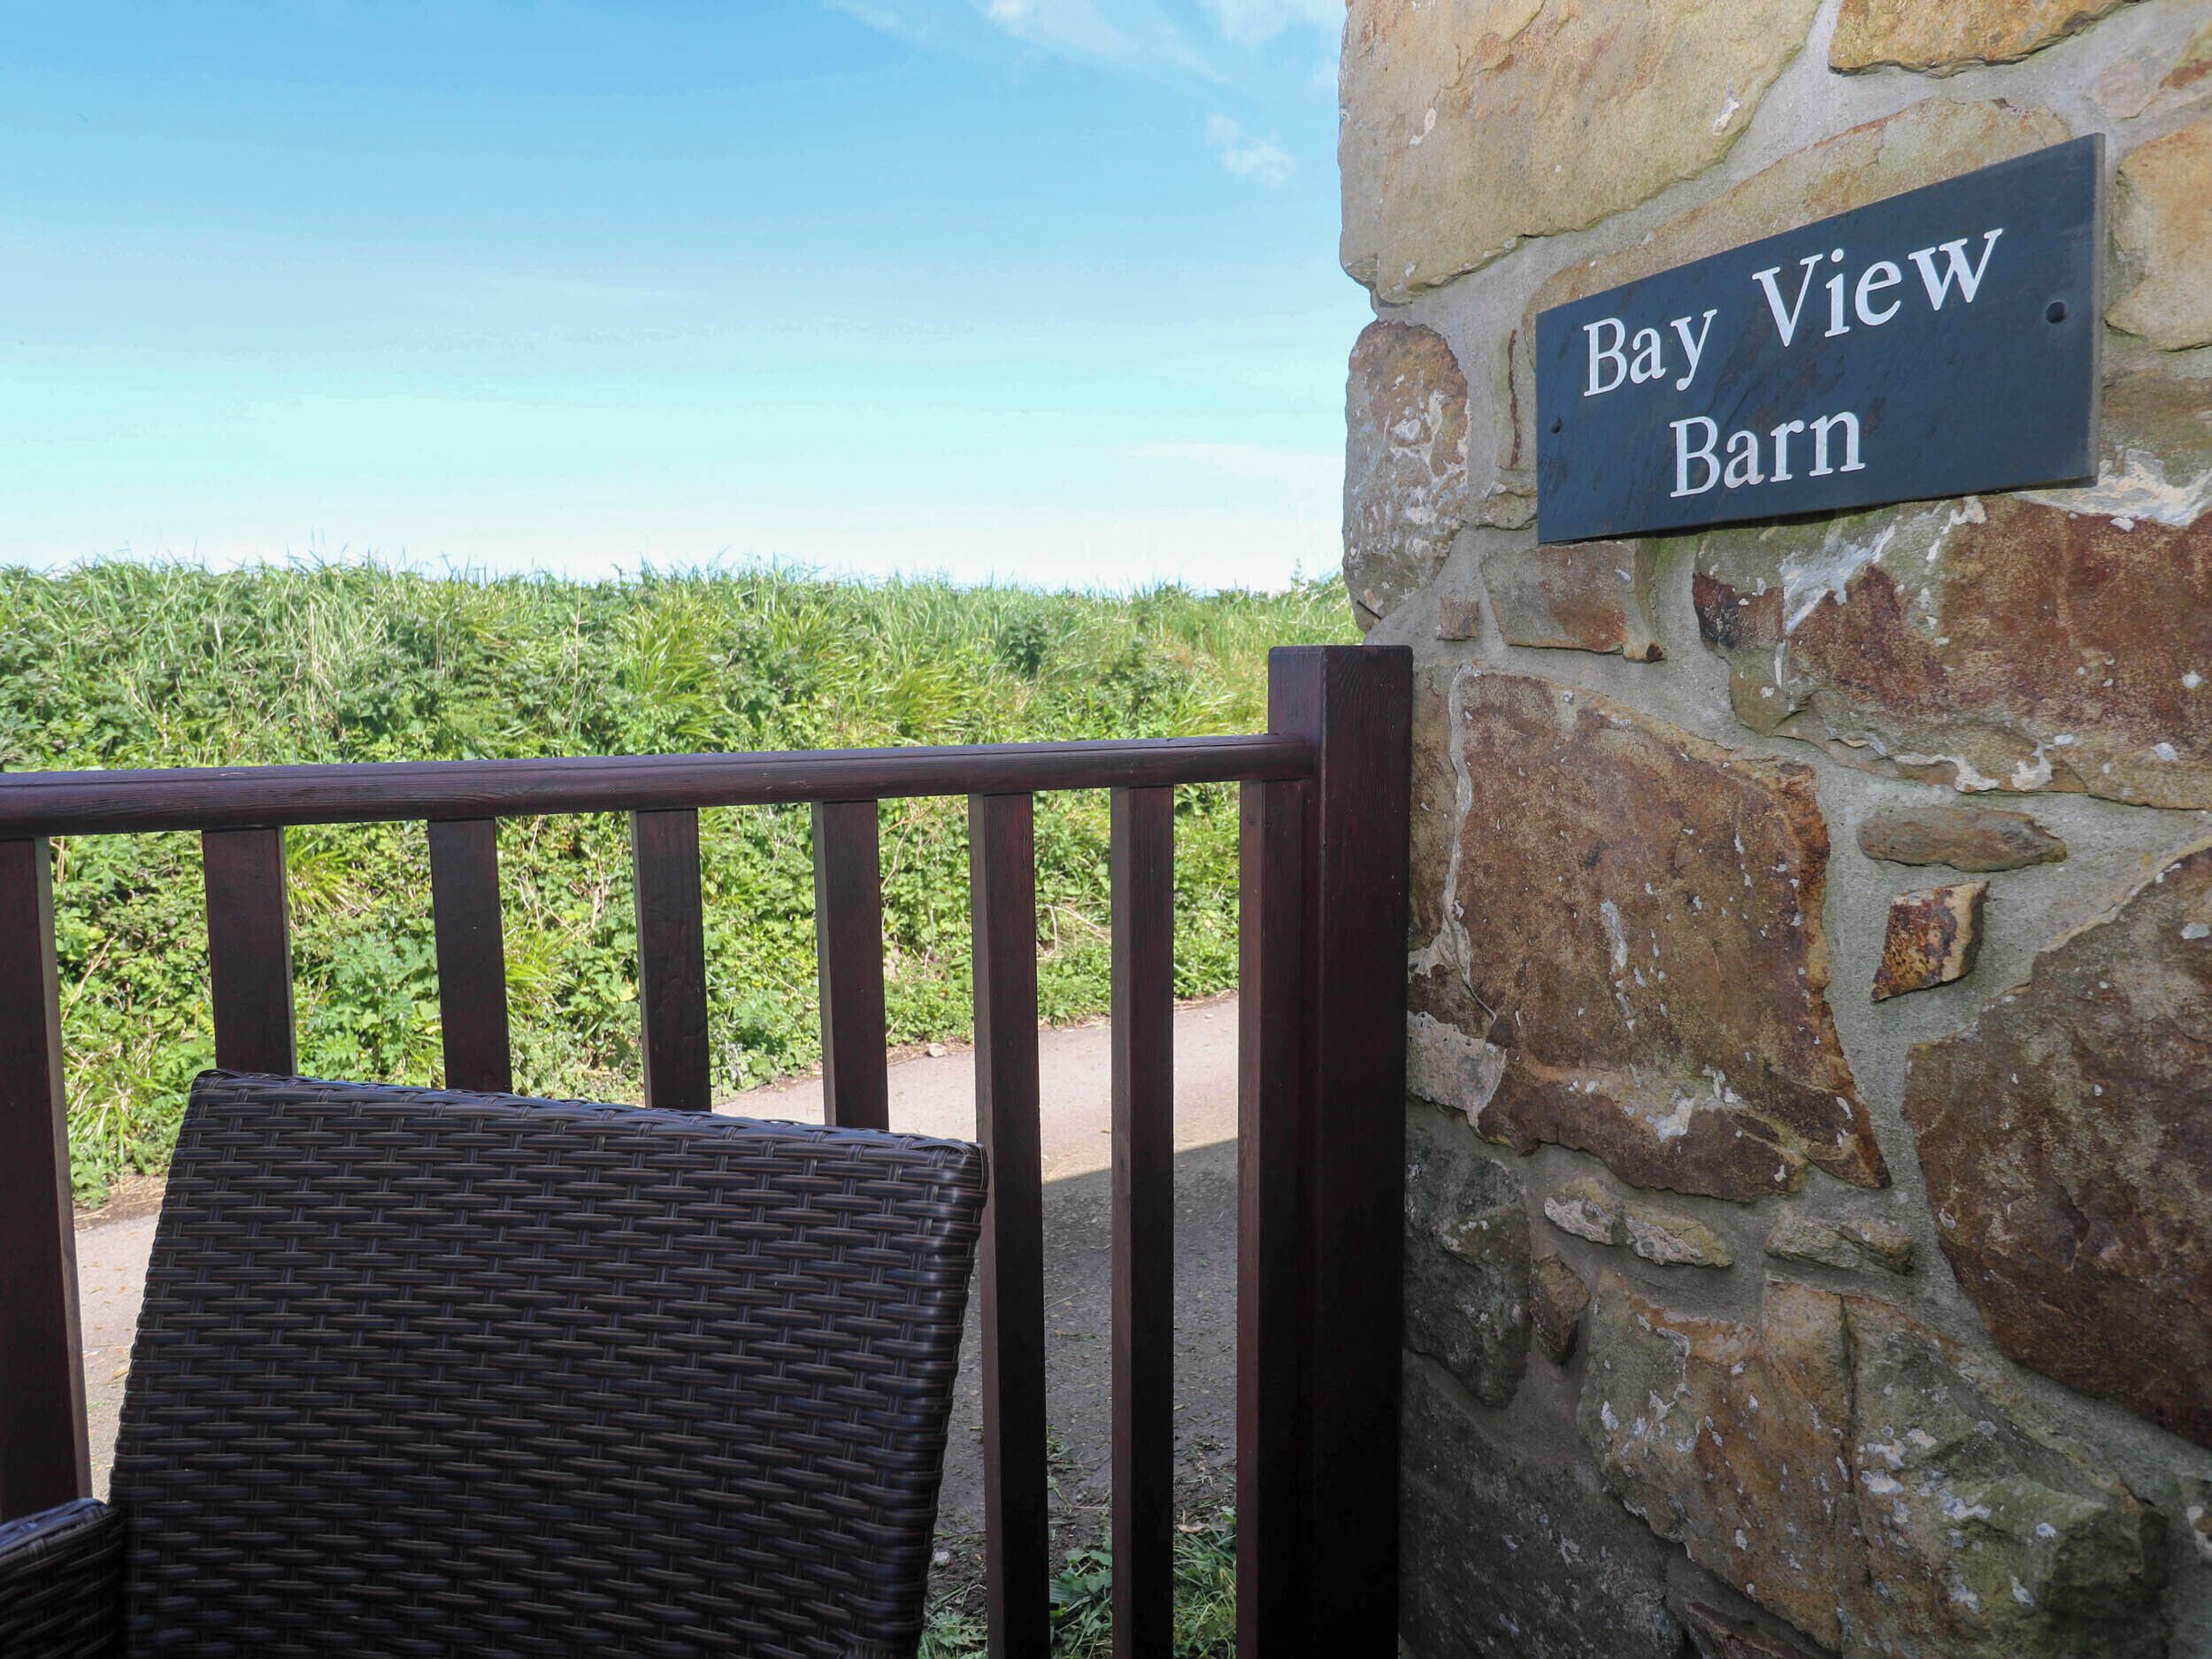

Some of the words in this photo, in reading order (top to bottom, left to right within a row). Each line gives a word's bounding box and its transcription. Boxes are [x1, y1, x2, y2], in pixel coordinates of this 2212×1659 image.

[1582, 309, 1717, 397] Bay
[1751, 227, 2003, 348] View
[1669, 411, 1866, 498] Barn
